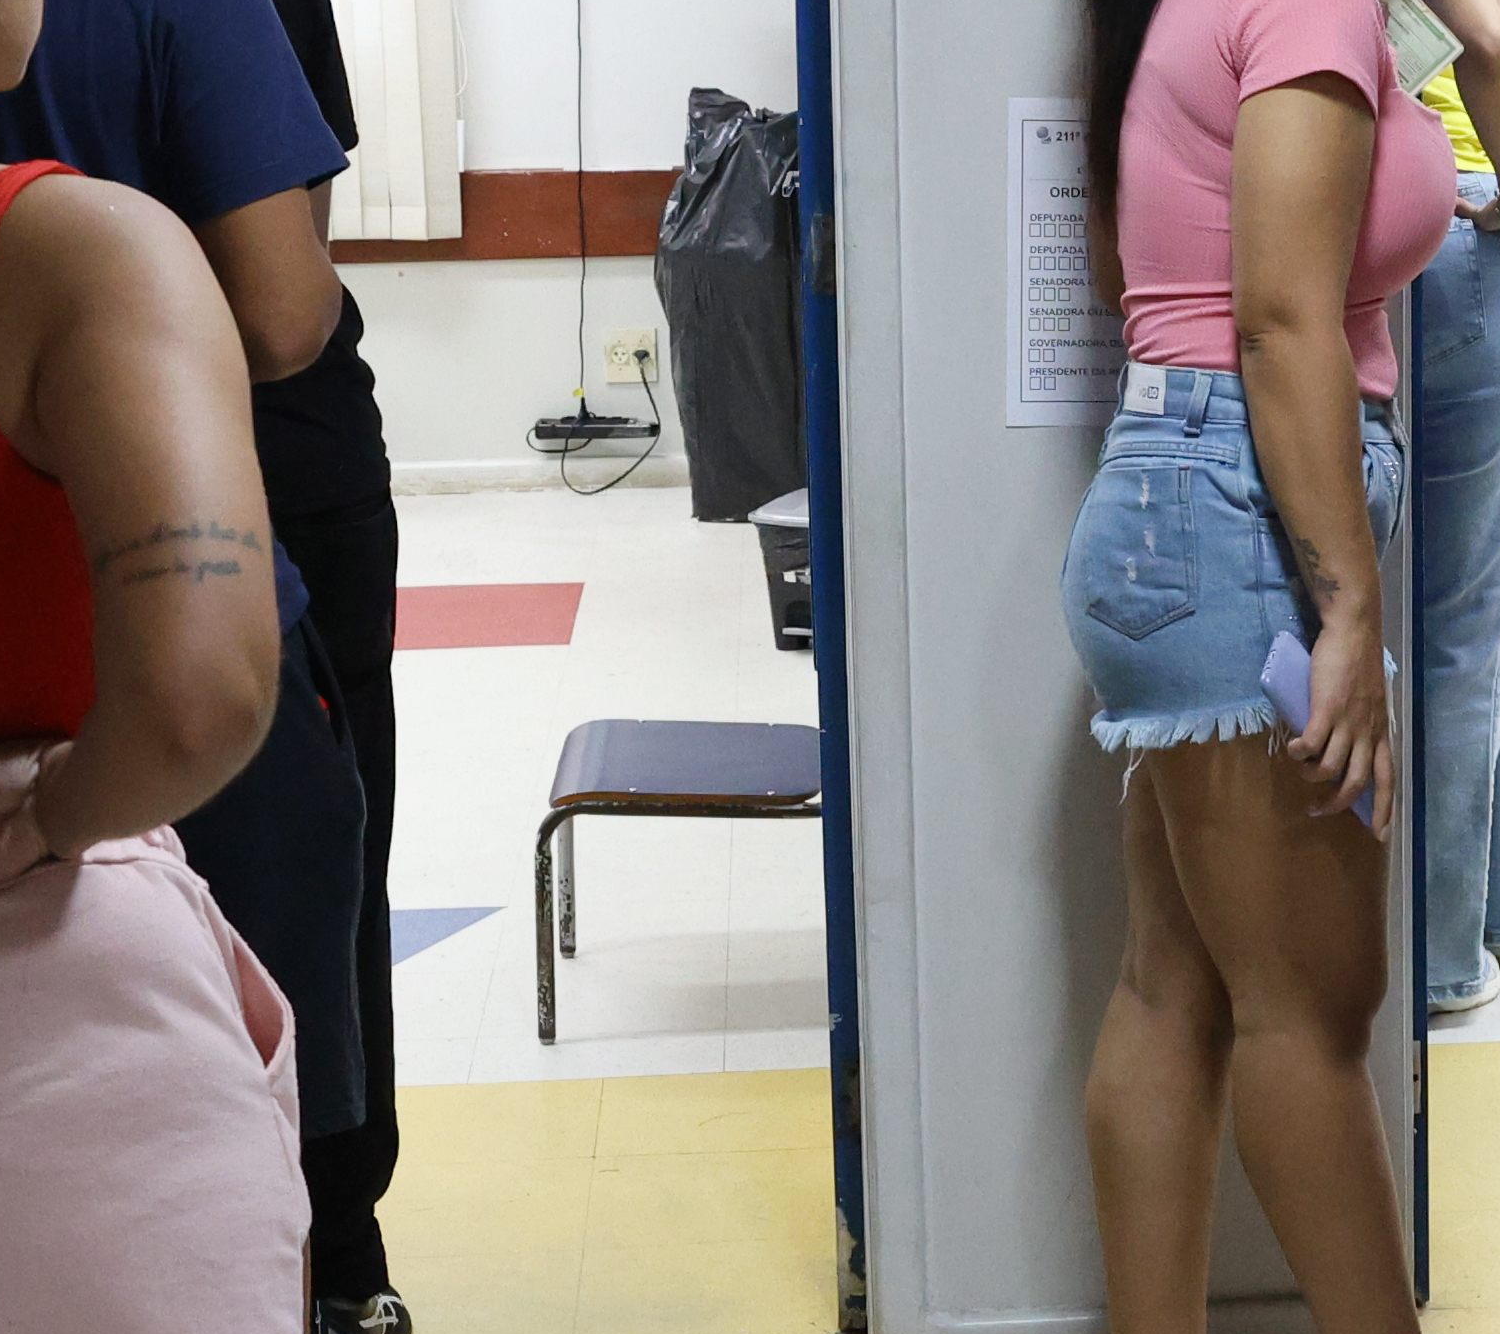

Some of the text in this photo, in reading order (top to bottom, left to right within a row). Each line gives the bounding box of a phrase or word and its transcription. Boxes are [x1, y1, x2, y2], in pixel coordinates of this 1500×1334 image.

[1050, 186, 1090, 198] ORDE
[1030, 213, 1085, 222] DEPUTADA
[1030, 246, 1085, 254] DEPUTADA
[1030, 277, 1086, 286] SENADORA
[1030, 307, 1085, 316] SENADORA
[1030, 339, 1107, 347] GOVERNADORA
[1030, 367, 1086, 376] PRESIDENTE
